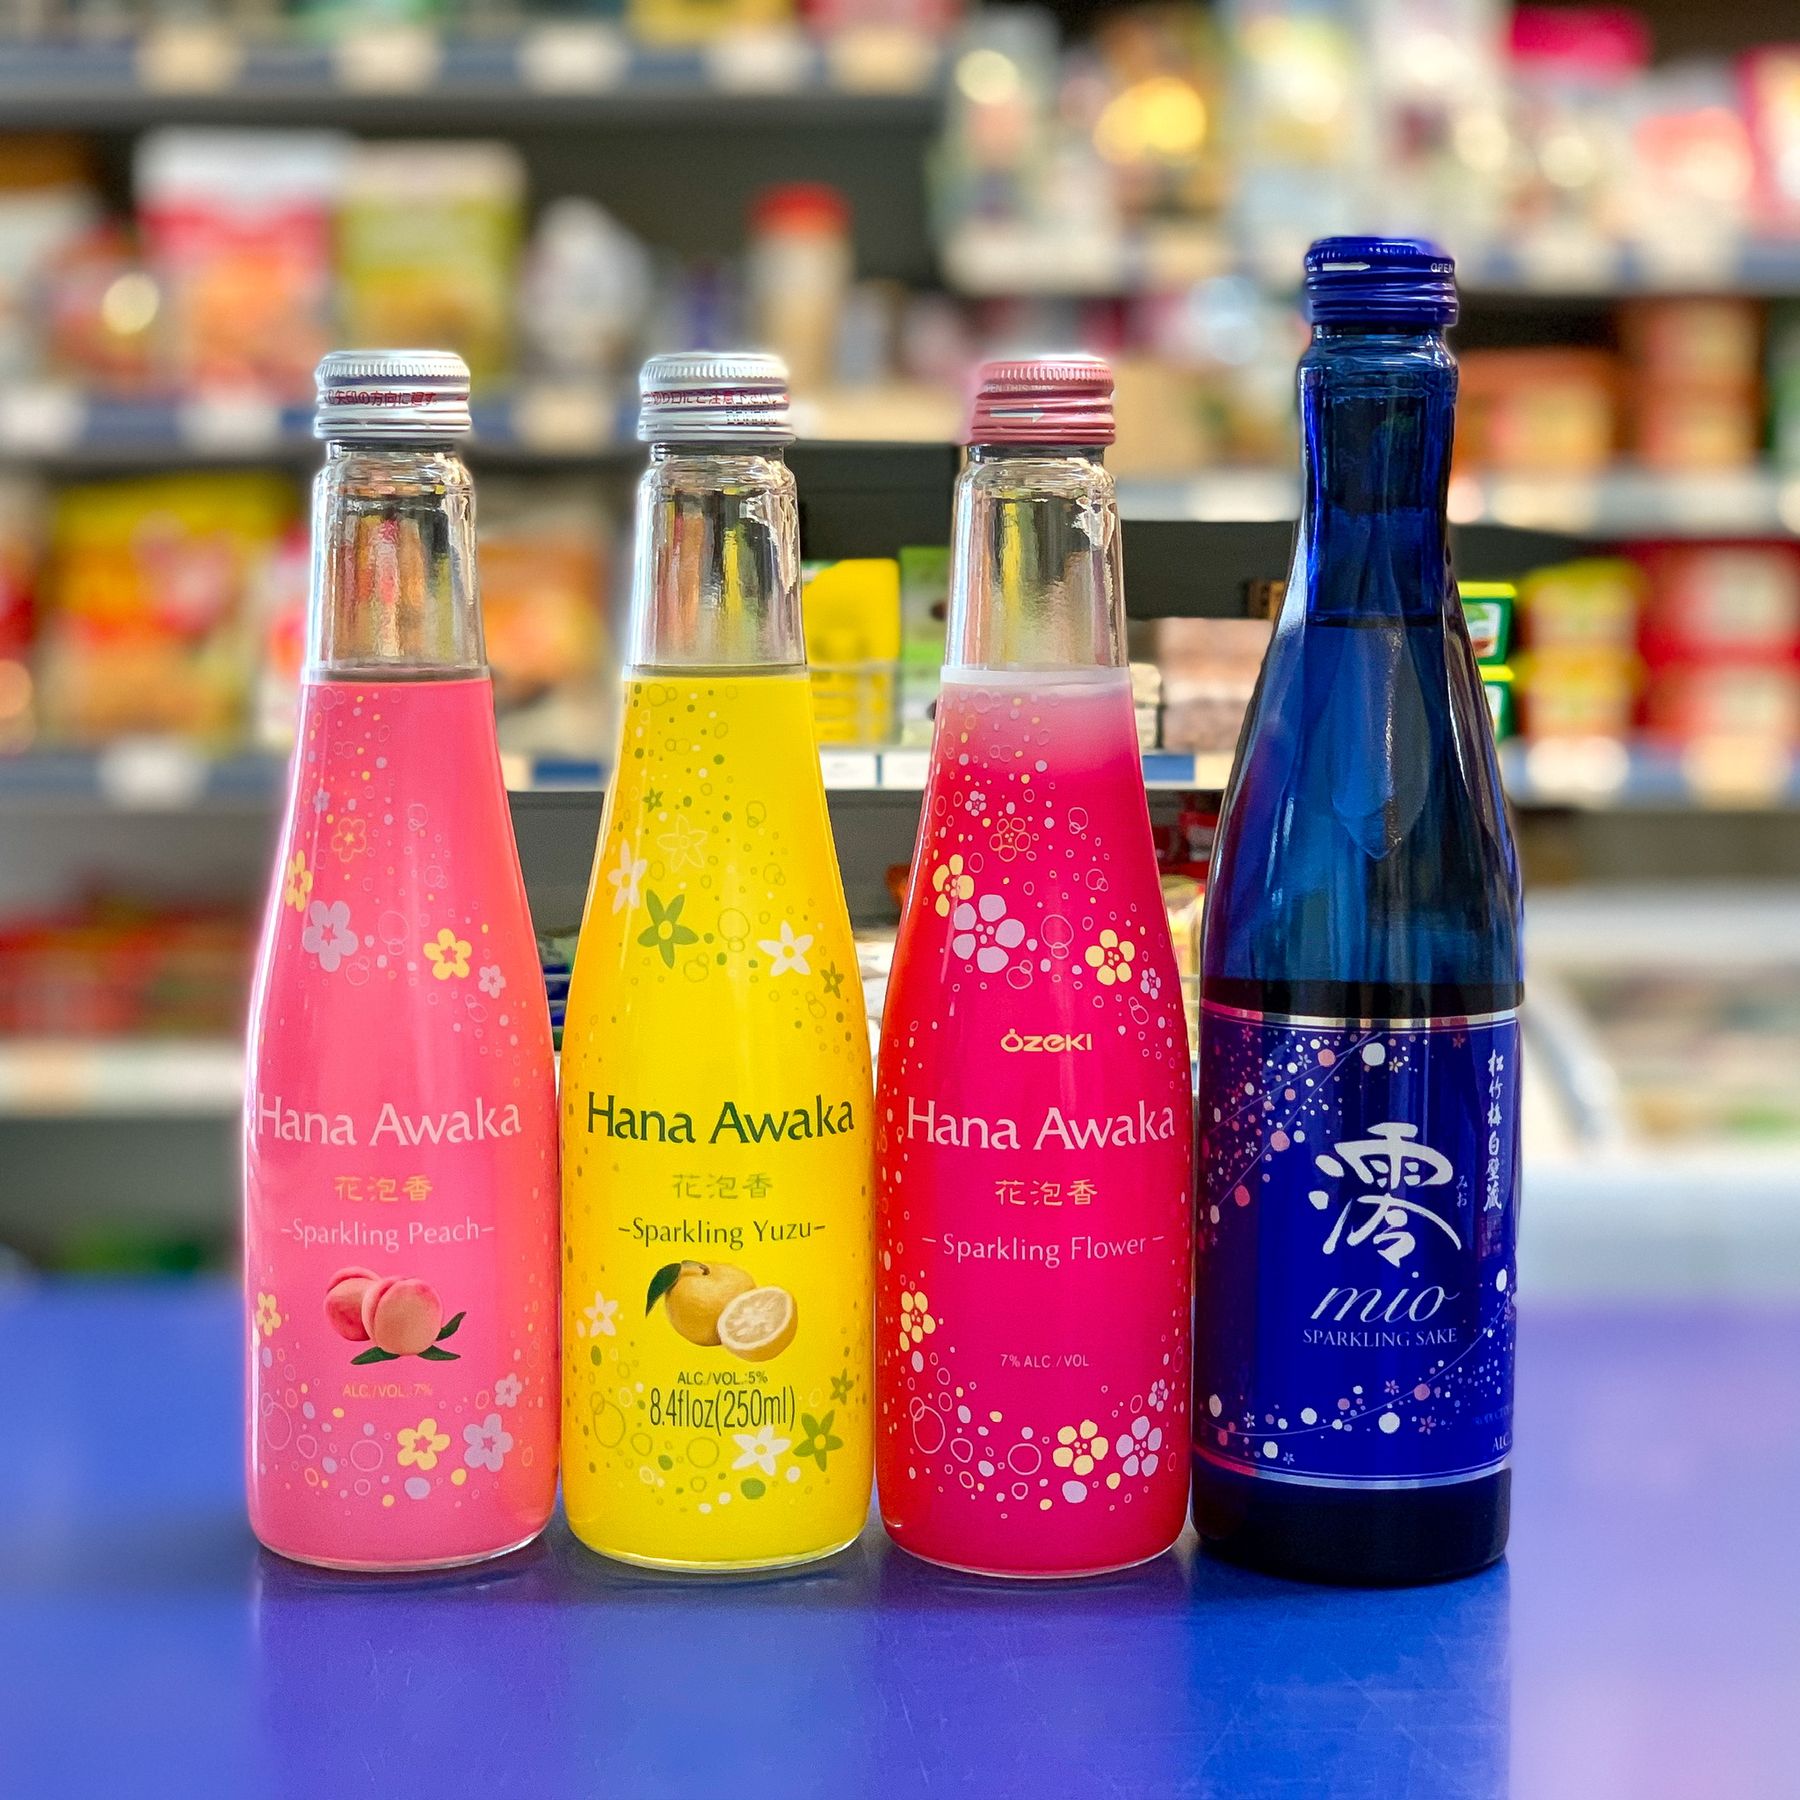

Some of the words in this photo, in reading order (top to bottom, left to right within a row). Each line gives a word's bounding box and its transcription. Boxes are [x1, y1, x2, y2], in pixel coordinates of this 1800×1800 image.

[257, 1092, 358, 1146] Hana
[369, 1096, 523, 1147] Awaka
[587, 1091, 697, 1144] Hana
[708, 1094, 856, 1145] Awaka
[906, 1096, 1021, 1151] Hana
[1033, 1099, 1176, 1151] Awaka
[334, 1175, 434, 1203] 花泡香
[672, 1173, 774, 1200] 花泡香
[994, 1178, 1098, 1207] 花泡香
[1310, 1271, 1460, 1323] mio
[1303, 1328, 1410, 1347] SPARKLING
[1416, 1327, 1457, 1345] SAKE
